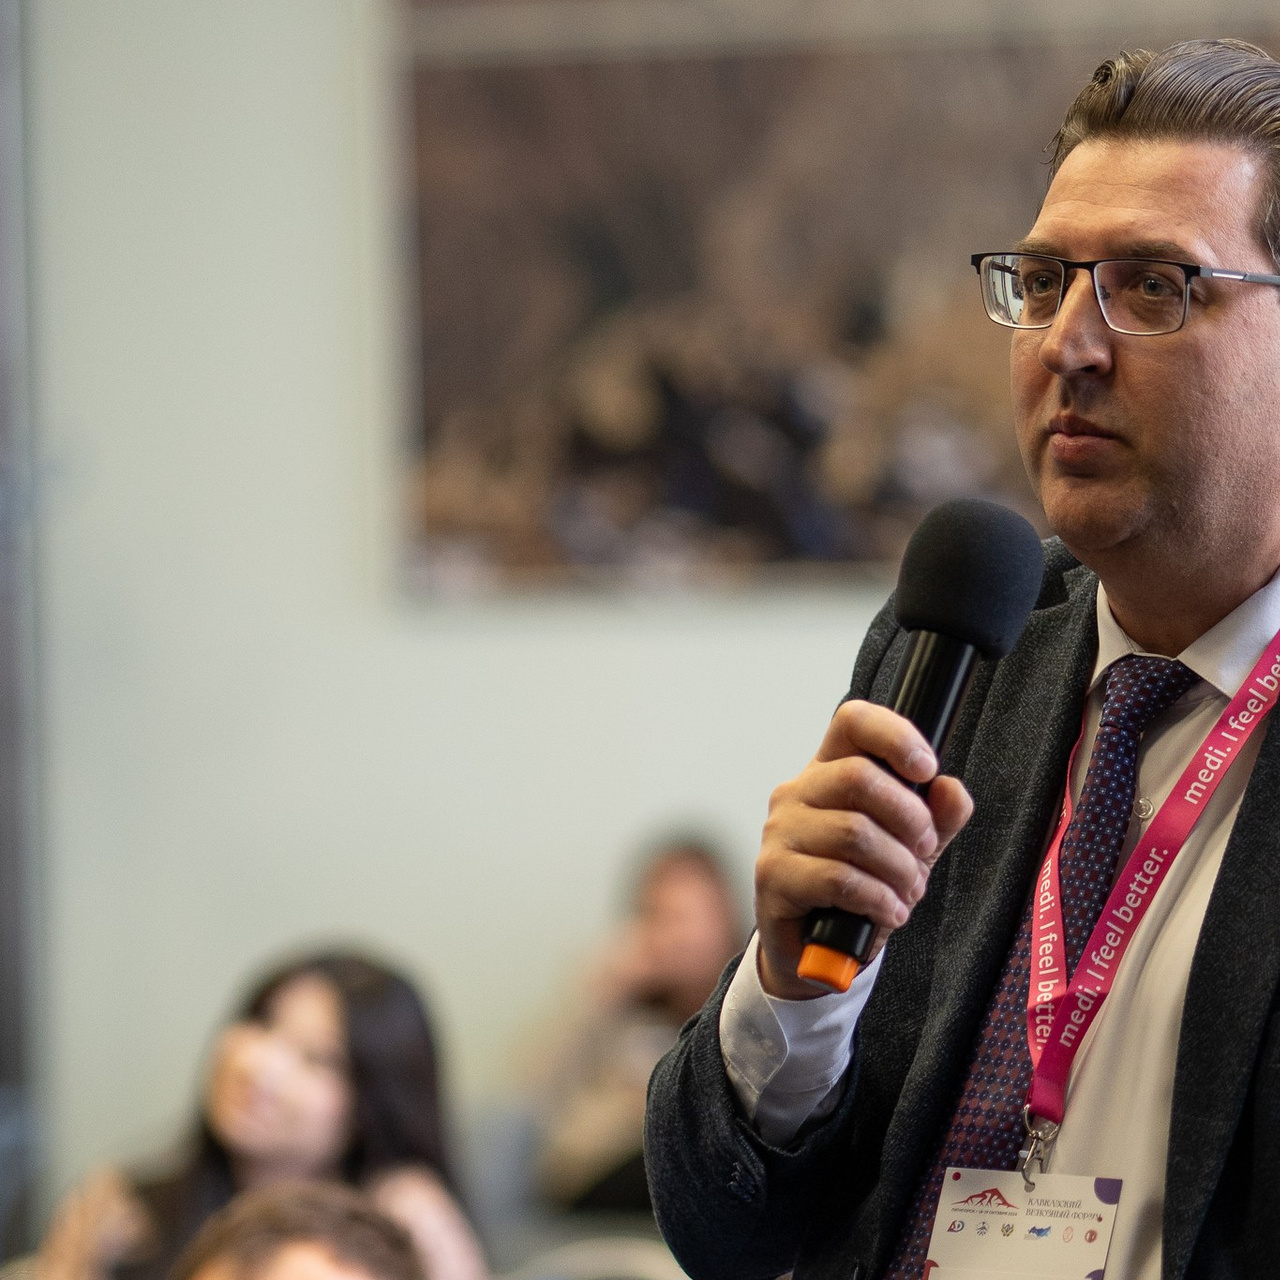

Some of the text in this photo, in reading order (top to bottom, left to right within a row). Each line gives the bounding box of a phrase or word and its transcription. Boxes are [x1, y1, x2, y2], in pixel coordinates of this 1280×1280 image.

[1228, 688, 1268, 731] feel
[1221, 731, 1238, 741] I
[1184, 746, 1231, 804] medi.
[1039, 858, 1056, 920] medi.
[1039, 932, 1058, 975] feel
[1059, 847, 1168, 1048] medi. I feel better.
